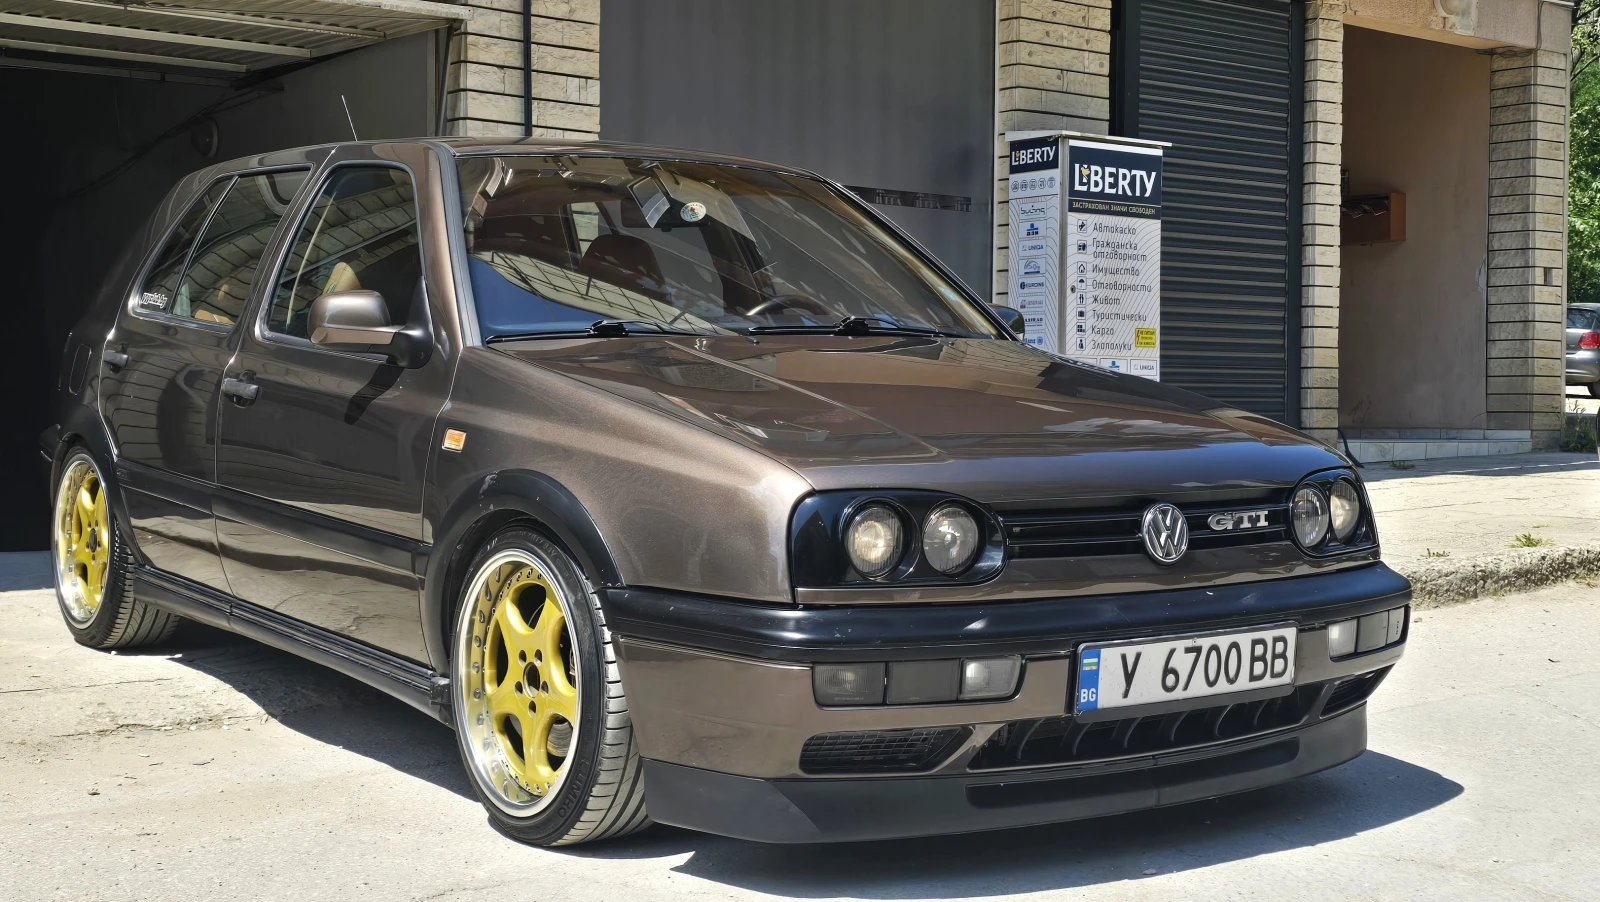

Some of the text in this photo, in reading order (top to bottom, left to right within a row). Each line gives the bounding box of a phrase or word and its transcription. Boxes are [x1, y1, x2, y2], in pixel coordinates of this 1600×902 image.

[1011, 145, 1056, 166] LIBERTY
[1074, 163, 1157, 197] LIBERTY
[1072, 201, 1156, 215] ЗАСТРАХОВАН ЗНАЧИ СВОБОДЕН
[1092, 222, 1137, 235] Автокаско
[1092, 237, 1138, 251] Гражданска
[1093, 250, 1147, 262] отговорност
[1092, 263, 1140, 277] Имущество
[1092, 279, 1152, 293] Отговорности
[1091, 294, 1121, 305] Живот
[1092, 309, 1147, 322] Туристически
[1091, 324, 1115, 337] Карго
[1091, 339, 1132, 352] Злополуки
[1207, 510, 1269, 531] GTI
[1161, 641, 1242, 693] 6700
[1248, 635, 1289, 683] BB
[1080, 688, 1097, 703] BG
